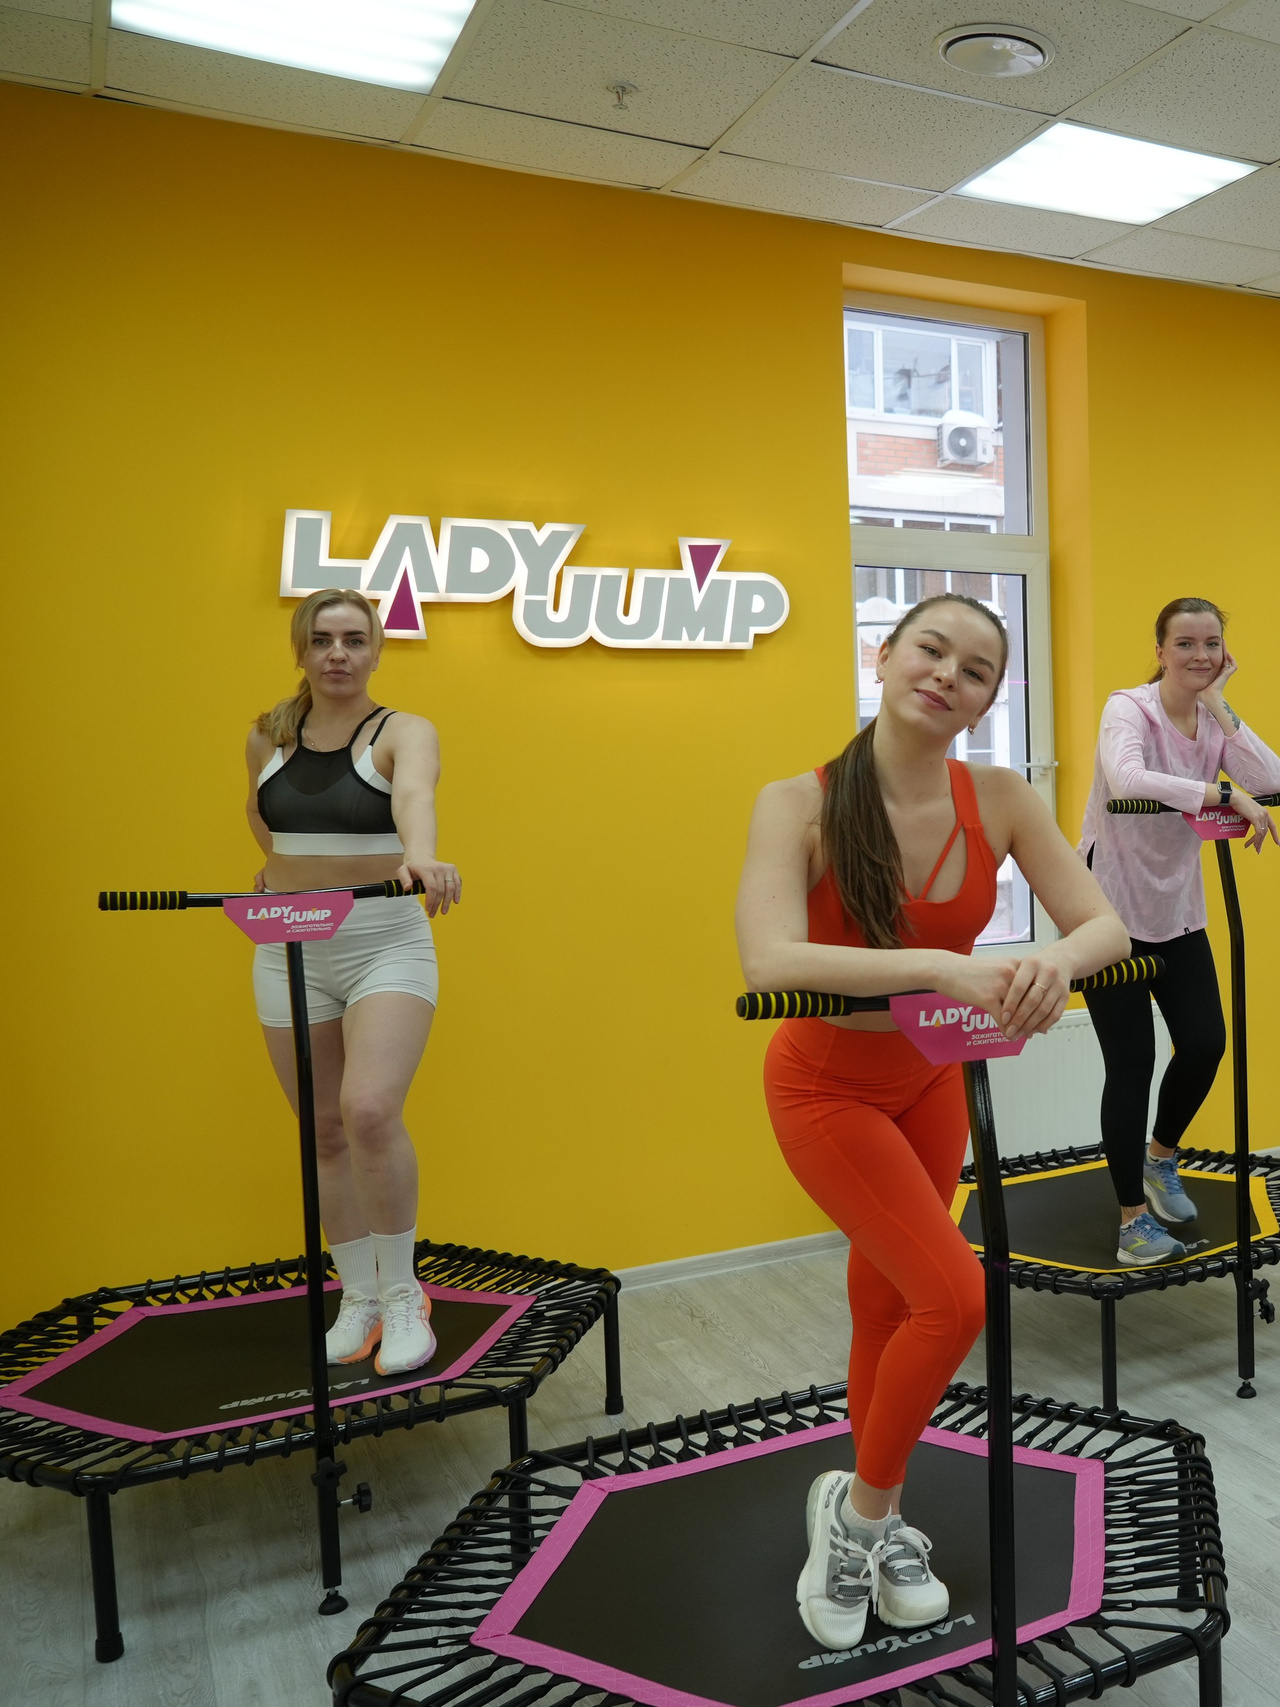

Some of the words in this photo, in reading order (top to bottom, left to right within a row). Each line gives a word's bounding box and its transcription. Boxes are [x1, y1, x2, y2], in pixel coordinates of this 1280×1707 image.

[281, 510, 585, 638] LADY
[514, 538, 789, 648] JUMP
[247, 906, 293, 920] LADY
[283, 908, 331, 924] JUMP
[919, 1006, 973, 1027] LADY
[219, 1389, 308, 1410] JUMP
[886, 1613, 976, 1653] LADY
[798, 1635, 900, 1669] JUMP
